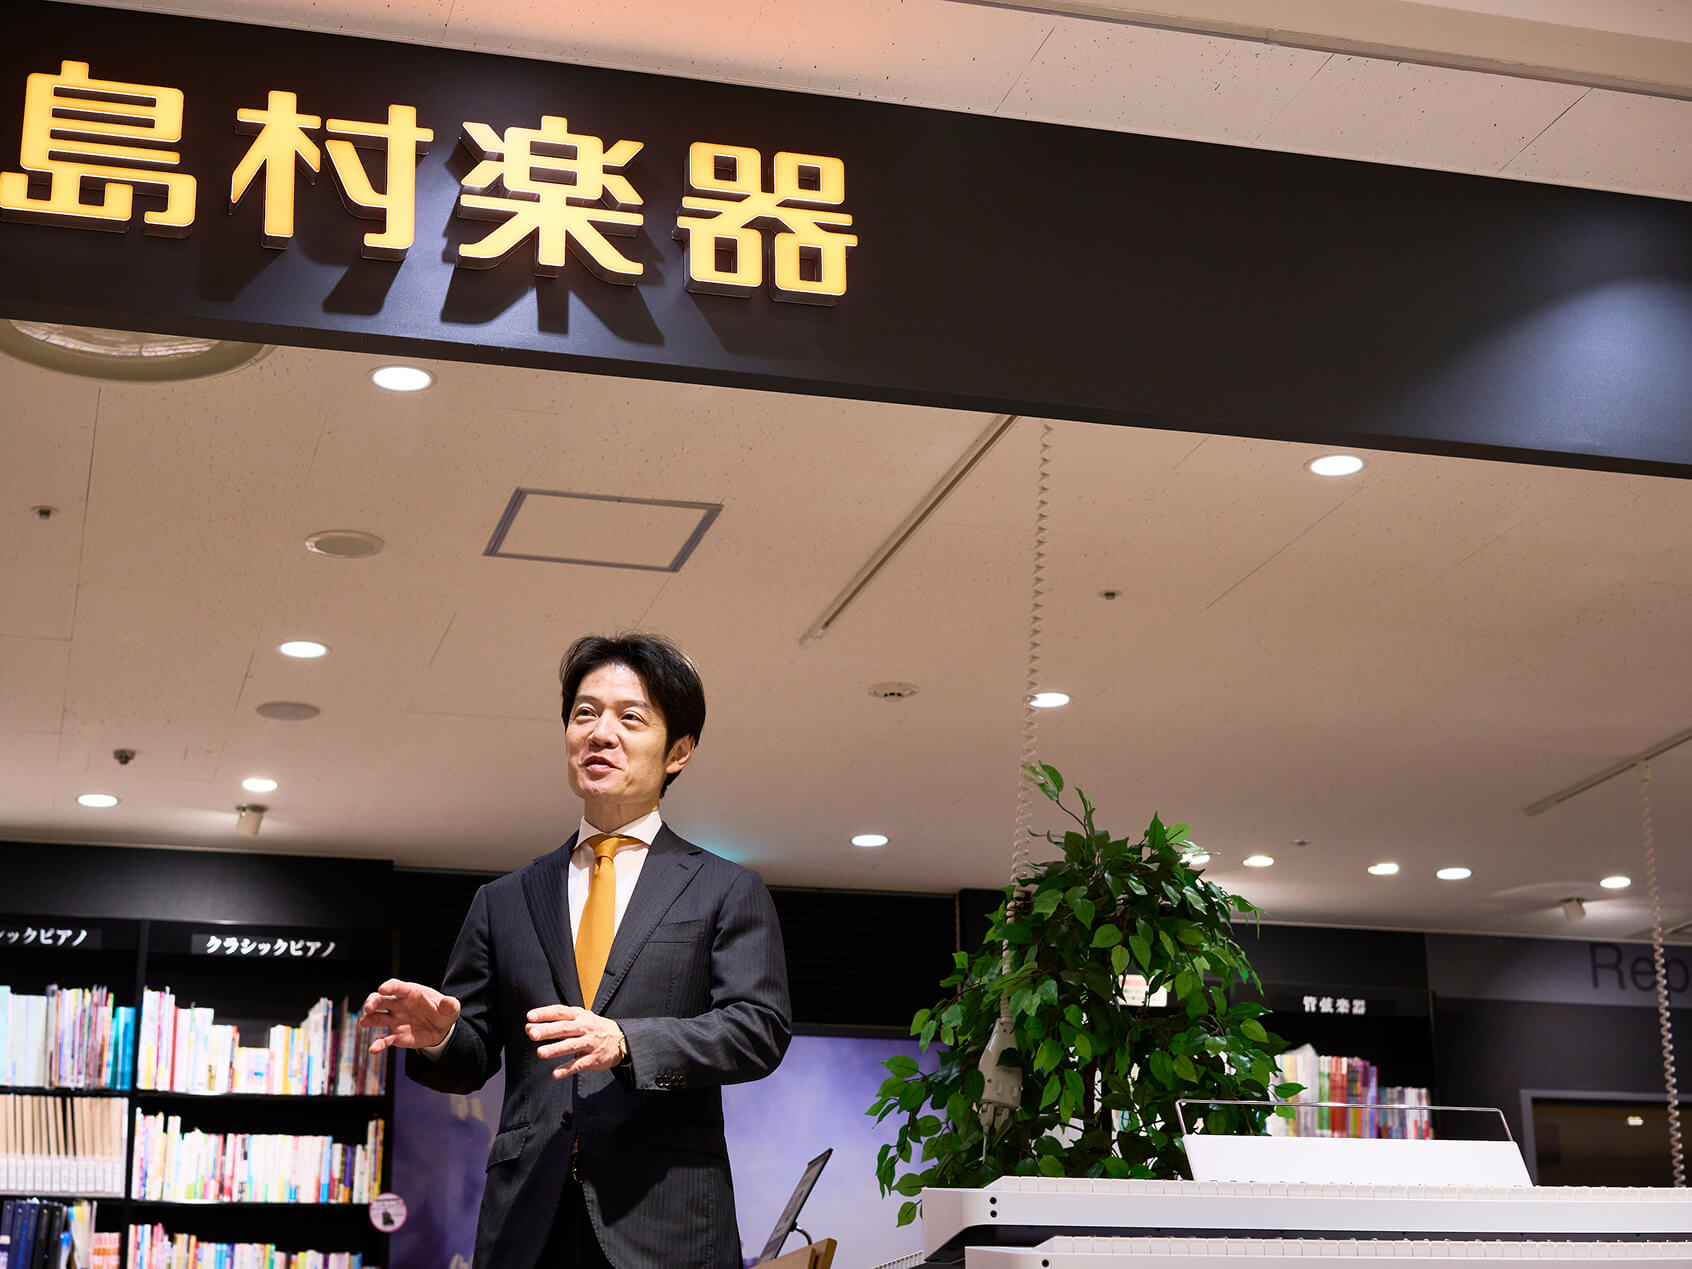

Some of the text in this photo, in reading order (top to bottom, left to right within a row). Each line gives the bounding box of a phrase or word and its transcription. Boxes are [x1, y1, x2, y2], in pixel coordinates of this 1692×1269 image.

[0, 60, 858, 297] 島村楽器
[206, 935, 336, 957] クラシックピアノ
